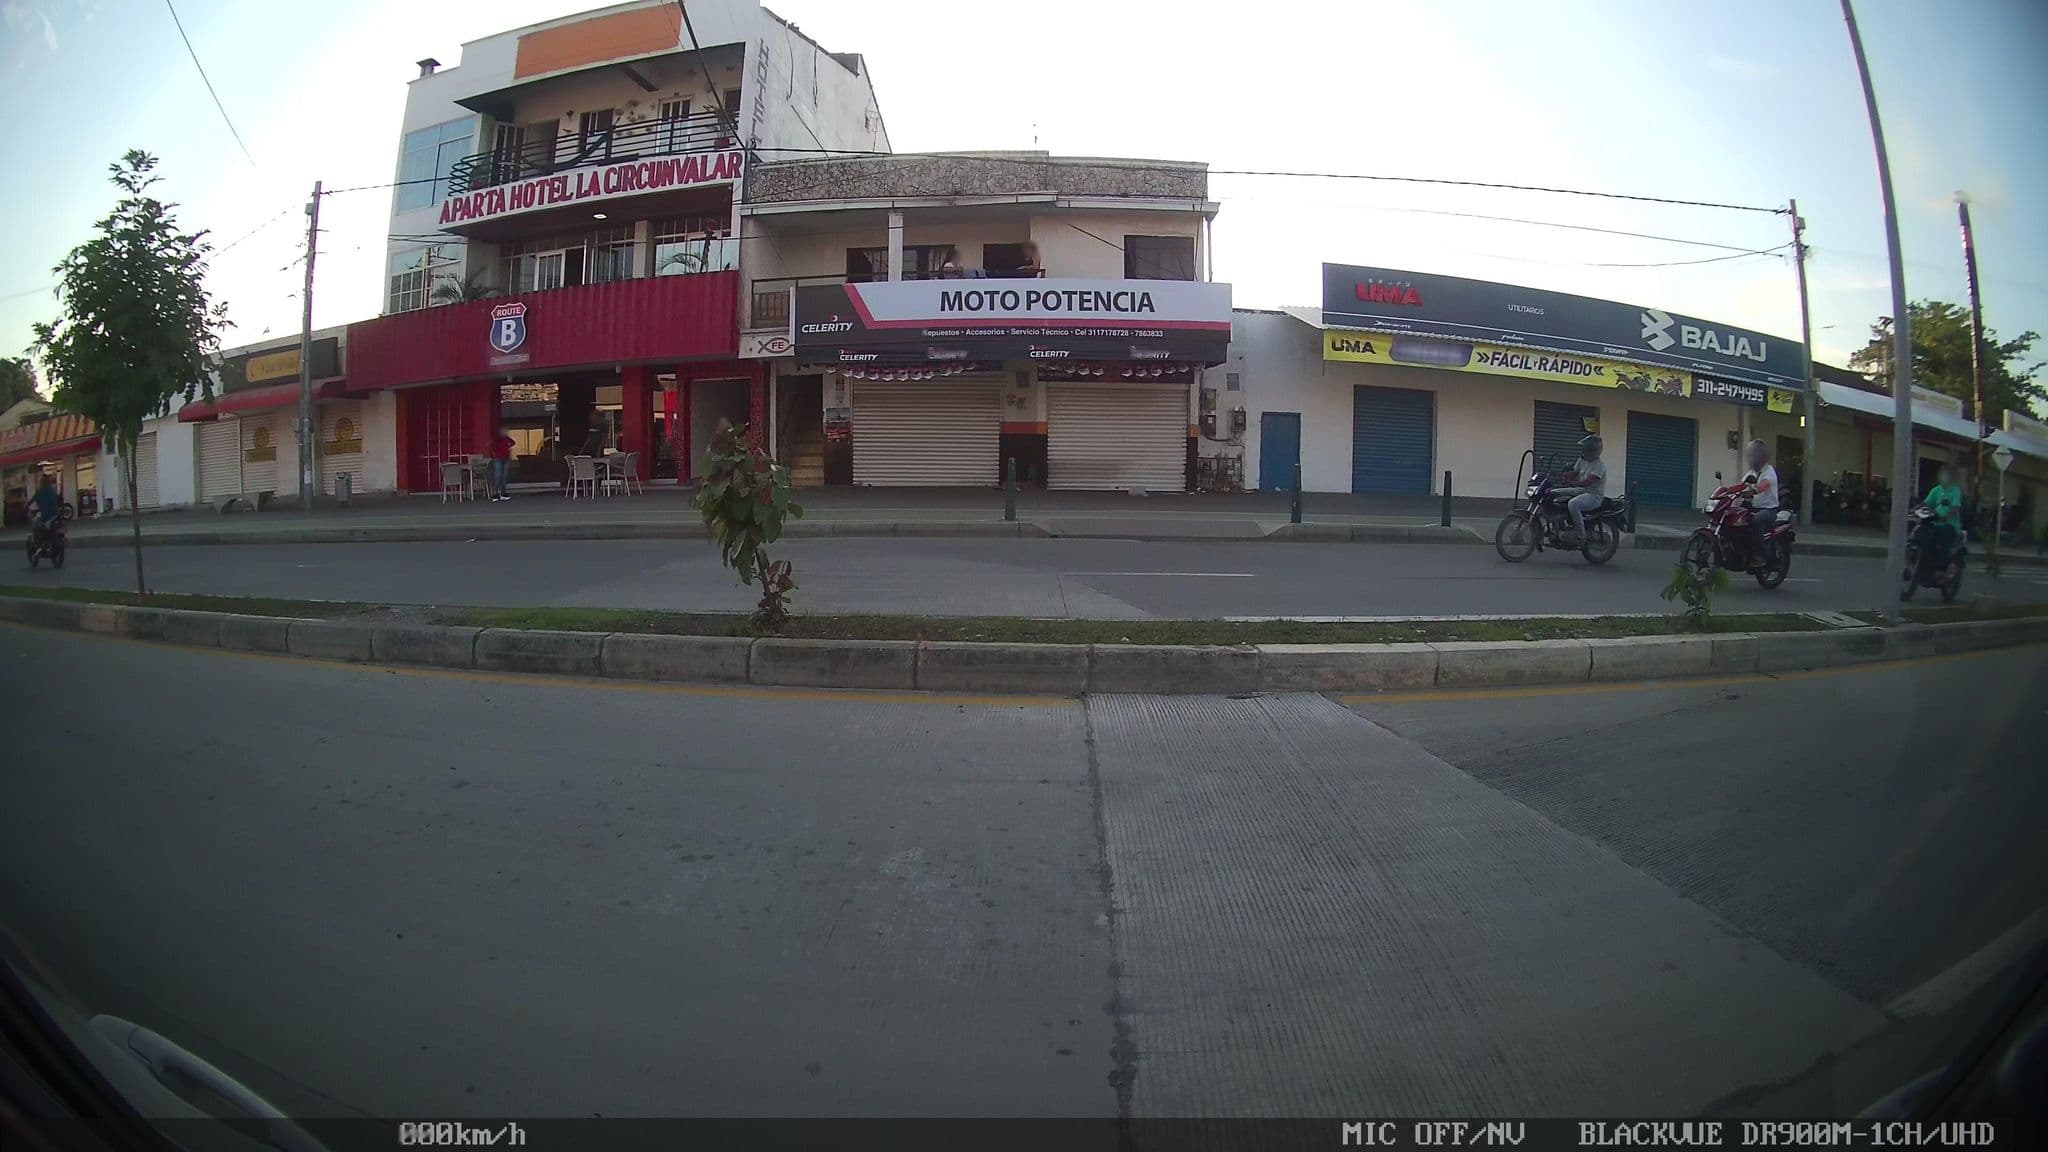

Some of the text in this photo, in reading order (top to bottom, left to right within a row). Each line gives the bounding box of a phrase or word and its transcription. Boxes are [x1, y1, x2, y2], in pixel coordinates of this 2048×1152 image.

[439, 151, 744, 224] APARTA HOTEL LA CIRCUNVALAR
[940, 290, 1155, 313] MOTO POTENCIA
[1355, 281, 1423, 307] UMA
[496, 306, 521, 317] ROUTE
[501, 319, 516, 347] B
[801, 322, 853, 333] CELERITY
[922, 328, 960, 337] epuestos
[965, 328, 1005, 336] Accesorios
[1010, 328, 1040, 336] Servicio
[1041, 328, 1069, 336] Técnico
[771, 341, 785, 350] FE
[1331, 338, 1376, 355] UMA
[1681, 325, 1767, 362] BAJAJ
[840, 353, 878, 361] CELERITY
[1029, 350, 1070, 359] CELERITY
[1490, 349, 1532, 370] FÁCIL
[1538, 354, 1592, 377] RÁPIDO
[1698, 378, 1765, 403] 311-2474495
